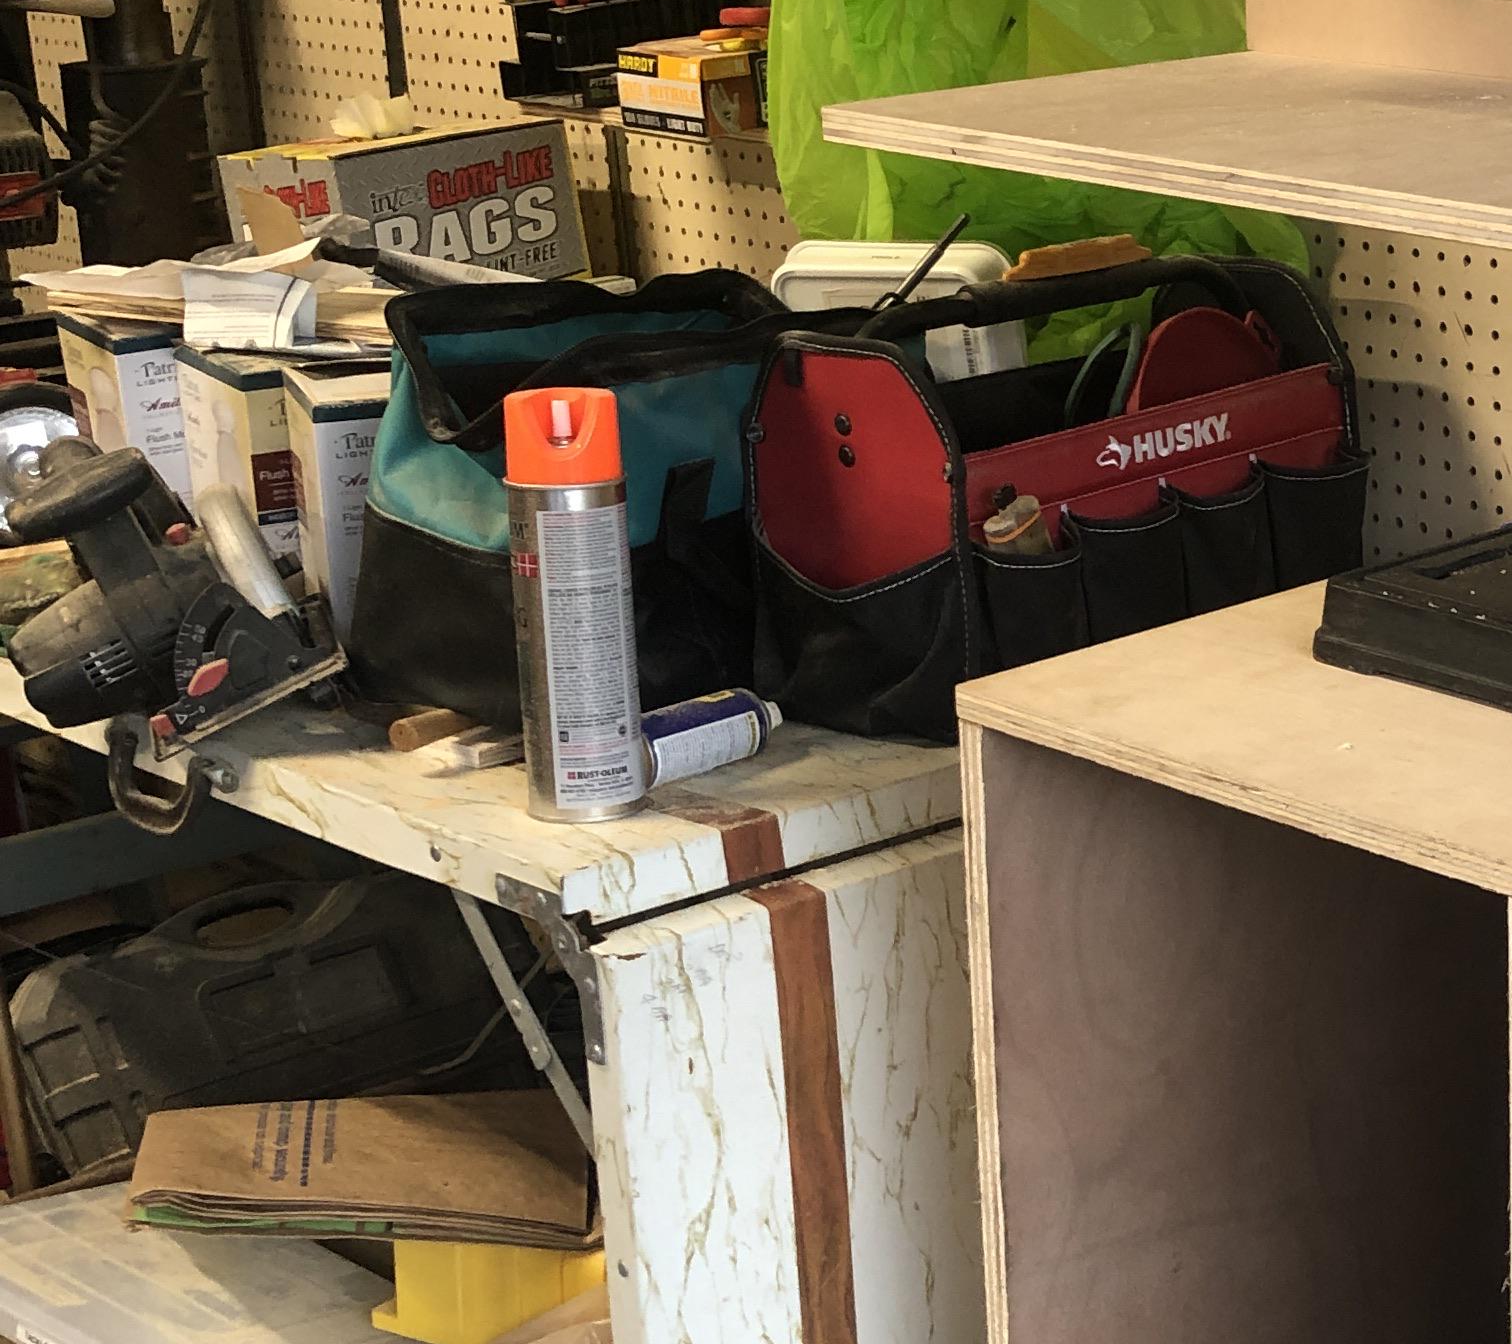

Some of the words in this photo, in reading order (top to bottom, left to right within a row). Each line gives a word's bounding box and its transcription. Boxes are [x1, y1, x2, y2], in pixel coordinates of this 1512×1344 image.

[427, 144, 555, 208] CLOTH-LIKE
[374, 185, 558, 263] RAGS
[141, 360, 177, 378] Patr
[1132, 413, 1228, 464] HUSKY
[577, 765, 628, 780] RUST-OLEUM
